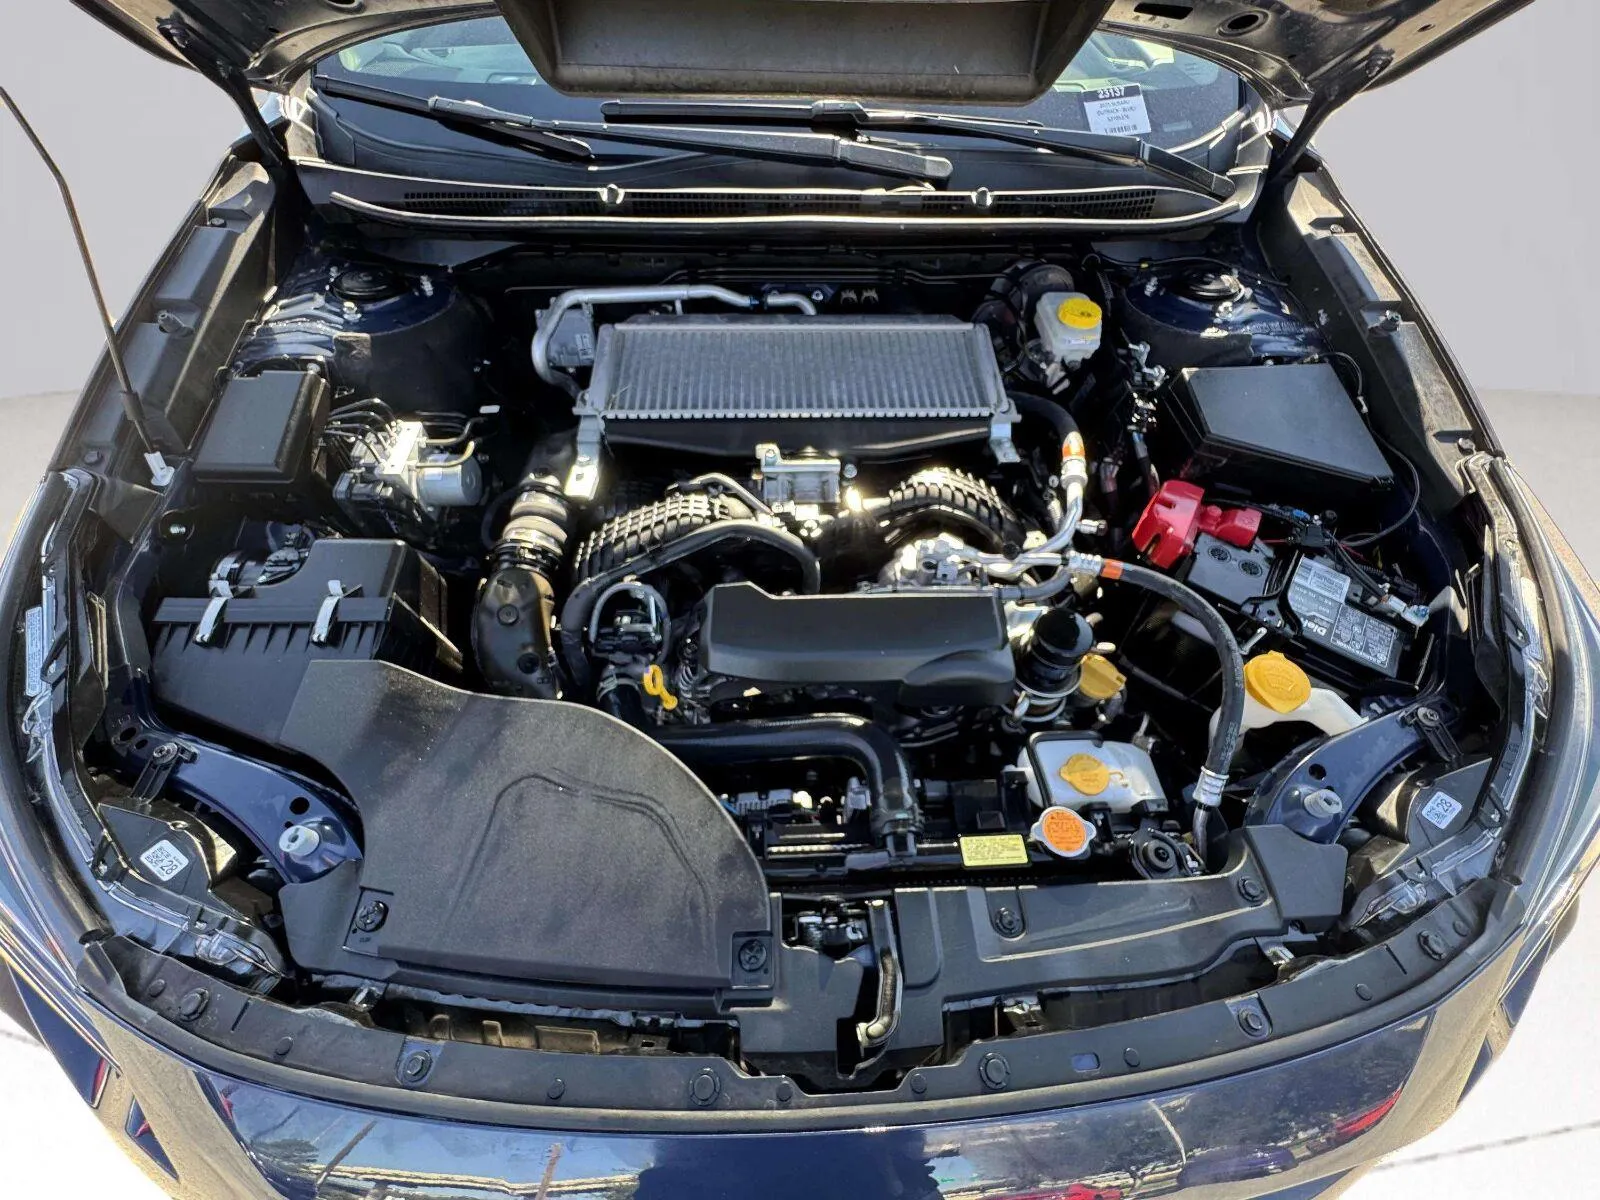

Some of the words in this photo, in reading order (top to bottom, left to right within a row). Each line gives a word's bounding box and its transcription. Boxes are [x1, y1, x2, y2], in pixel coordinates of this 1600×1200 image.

[1097, 86, 1125, 99] 23137
[1436, 798, 1453, 813] 28
[160, 860, 178, 875] 28
